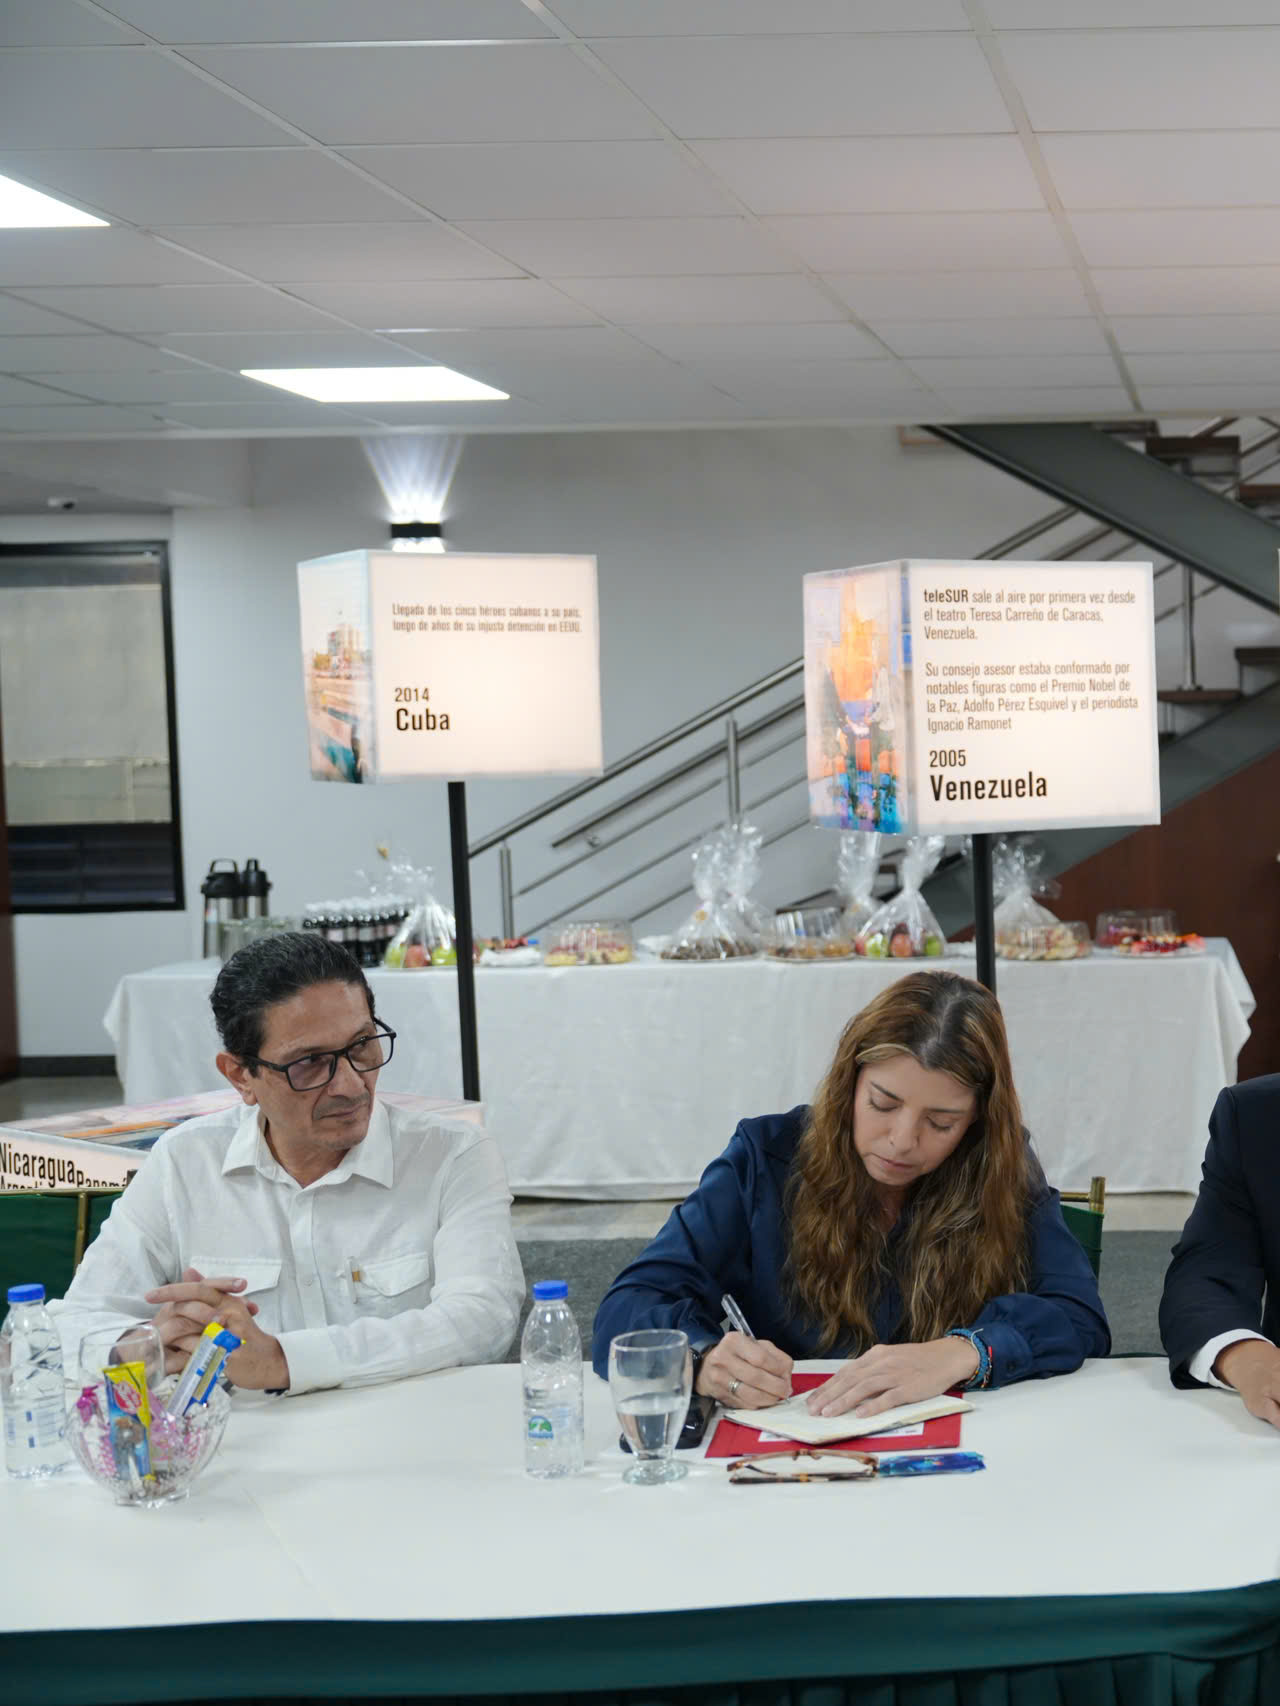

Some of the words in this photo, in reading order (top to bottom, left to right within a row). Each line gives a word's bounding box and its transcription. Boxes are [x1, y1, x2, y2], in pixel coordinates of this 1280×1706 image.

[924, 589, 969, 603] teleSUR
[972, 590, 992, 603] sale
[996, 590, 1004, 603] al
[1008, 590, 1026, 603] aire
[1029, 592, 1045, 605] por
[1049, 590, 1086, 605] primera
[1089, 591, 1105, 603] vez
[1108, 590, 1135, 604] desde
[428, 605, 436, 616] de
[440, 605, 452, 616] los
[544, 608, 549, 617] a
[552, 608, 560, 617] su
[924, 609, 932, 620] el
[936, 610, 966, 621] teatro
[970, 608, 1002, 621] Teresa
[1047, 608, 1059, 621] de
[419, 621, 428, 631] de
[454, 621, 463, 631] de
[467, 622, 475, 631] su
[926, 663, 938, 676] Su
[943, 663, 980, 679] consejo
[984, 665, 1015, 676] asesor
[1019, 663, 1051, 674] estaba
[1054, 662, 1112, 674] conformado
[1115, 663, 1130, 676] por
[394, 687, 430, 702] 2014
[926, 681, 969, 695] notables
[973, 681, 1006, 696] figuras
[1010, 683, 1037, 694] como
[1040, 680, 1048, 693] el
[1051, 680, 1086, 692] Premio
[1089, 679, 1116, 691] Nobel
[1119, 679, 1130, 690] de
[927, 700, 936, 713] la
[963, 699, 994, 712] Adolfo
[1029, 697, 1068, 712] Esquivel
[1071, 699, 1076, 711] y
[1080, 698, 1089, 709] el
[1092, 696, 1138, 709] periodista
[396, 707, 451, 731] Cuba
[927, 718, 964, 734] Ignacio
[967, 717, 1012, 730] Ramonet
[929, 749, 967, 768] 2005
[930, 771, 1047, 801] Venezuela
[0, 1142, 75, 1188] Nicaragua
